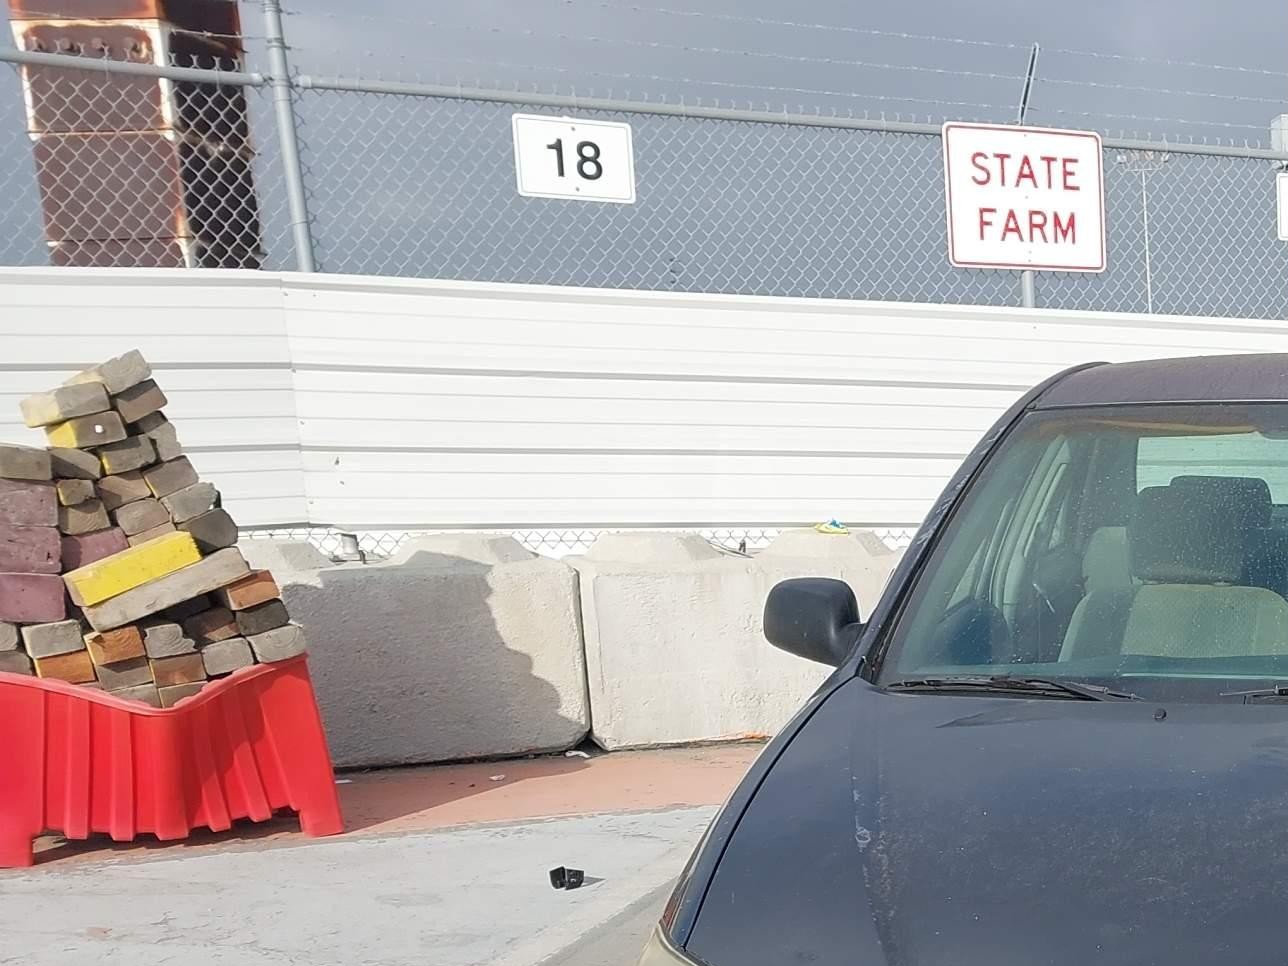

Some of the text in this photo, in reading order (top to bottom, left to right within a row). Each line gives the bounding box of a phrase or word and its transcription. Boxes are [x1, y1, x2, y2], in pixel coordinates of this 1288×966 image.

[546, 138, 603, 181] 18
[970, 151, 1081, 191] STATE
[978, 206, 1077, 244] FARM
